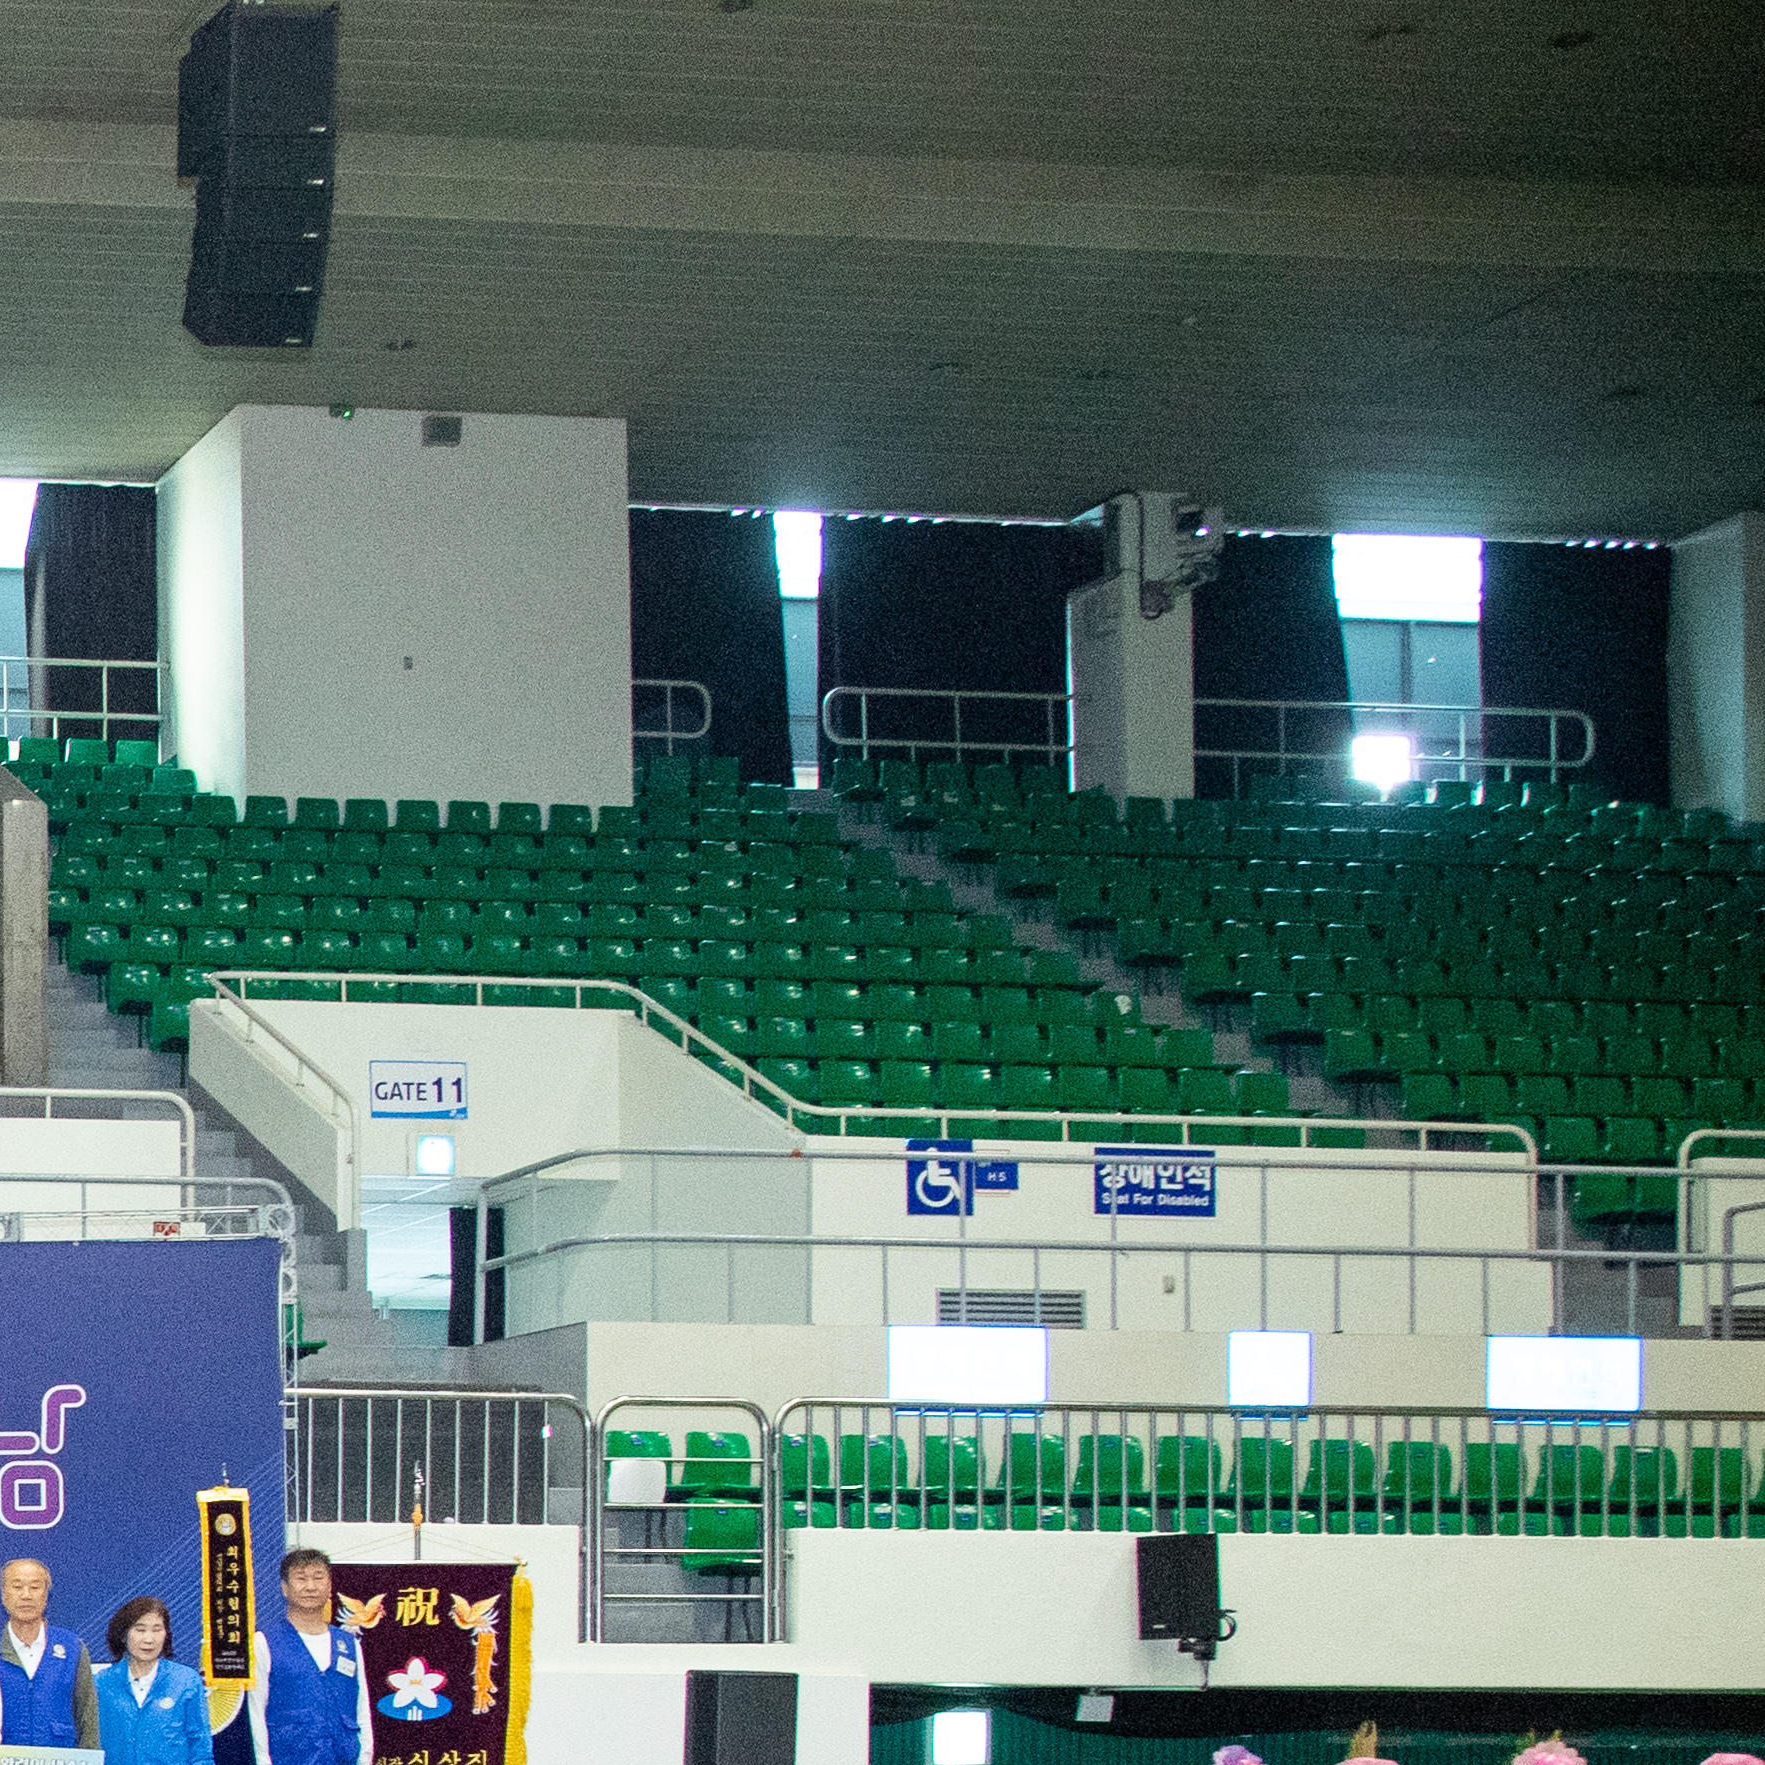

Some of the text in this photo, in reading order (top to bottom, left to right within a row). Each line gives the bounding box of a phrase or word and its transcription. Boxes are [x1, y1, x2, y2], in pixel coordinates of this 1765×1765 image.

[374, 1076, 463, 1103] GATE 11
[1099, 1162, 1212, 1191] 장애인석
[1102, 1192, 1210, 1207] Sat For Disabled
[395, 1586, 440, 1627] 祝
